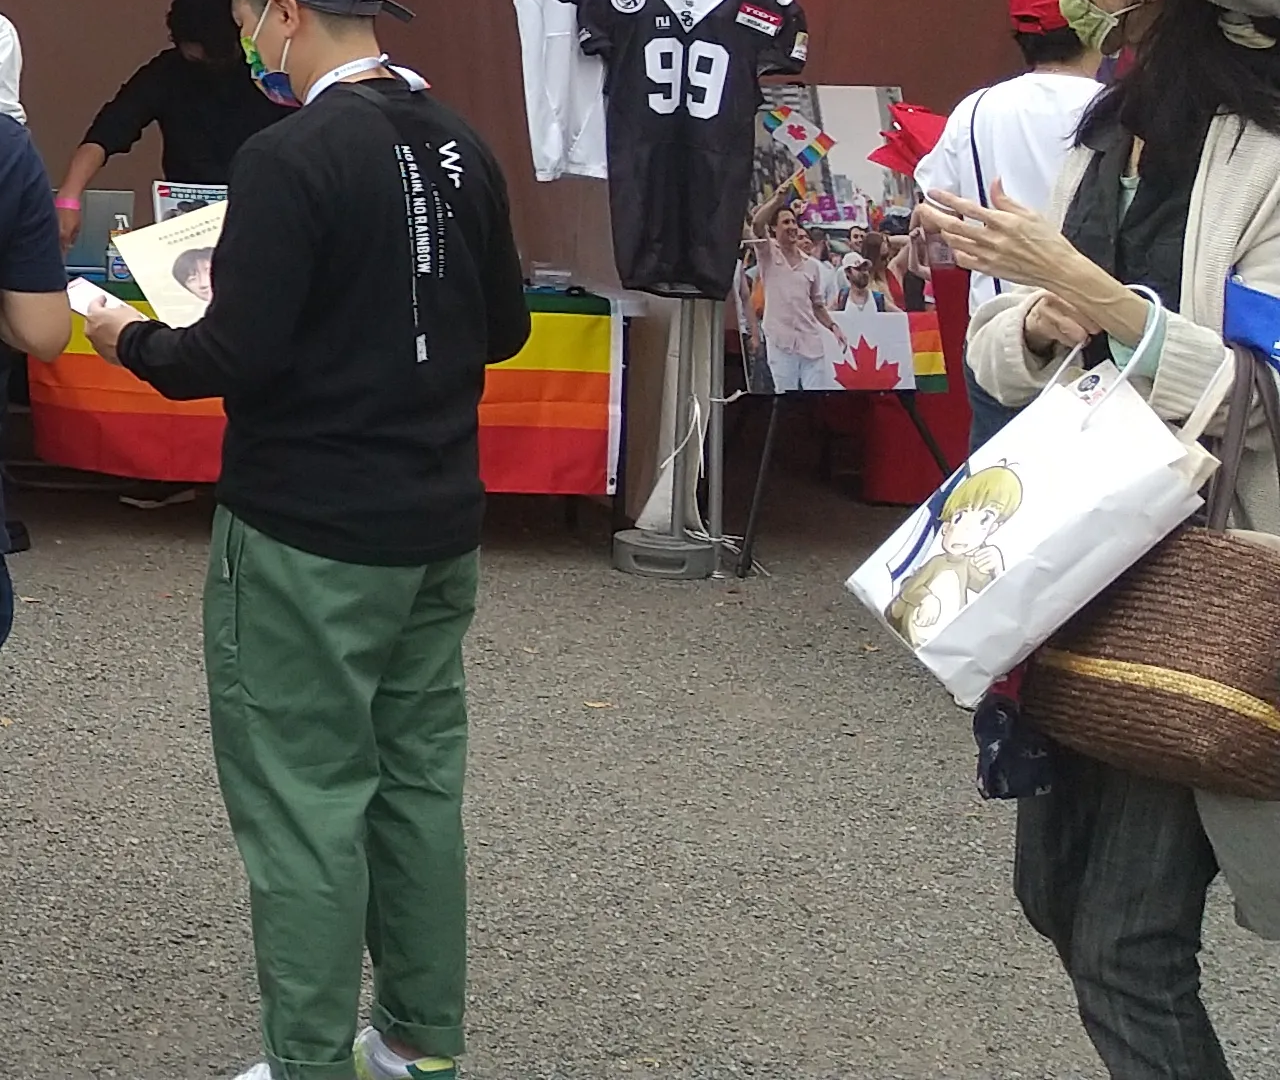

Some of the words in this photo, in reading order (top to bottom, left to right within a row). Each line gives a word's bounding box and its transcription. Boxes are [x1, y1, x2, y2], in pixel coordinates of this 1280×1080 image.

[644, 37, 730, 120] 99
[401, 144, 415, 162] NO
[413, 196, 428, 215] NO
